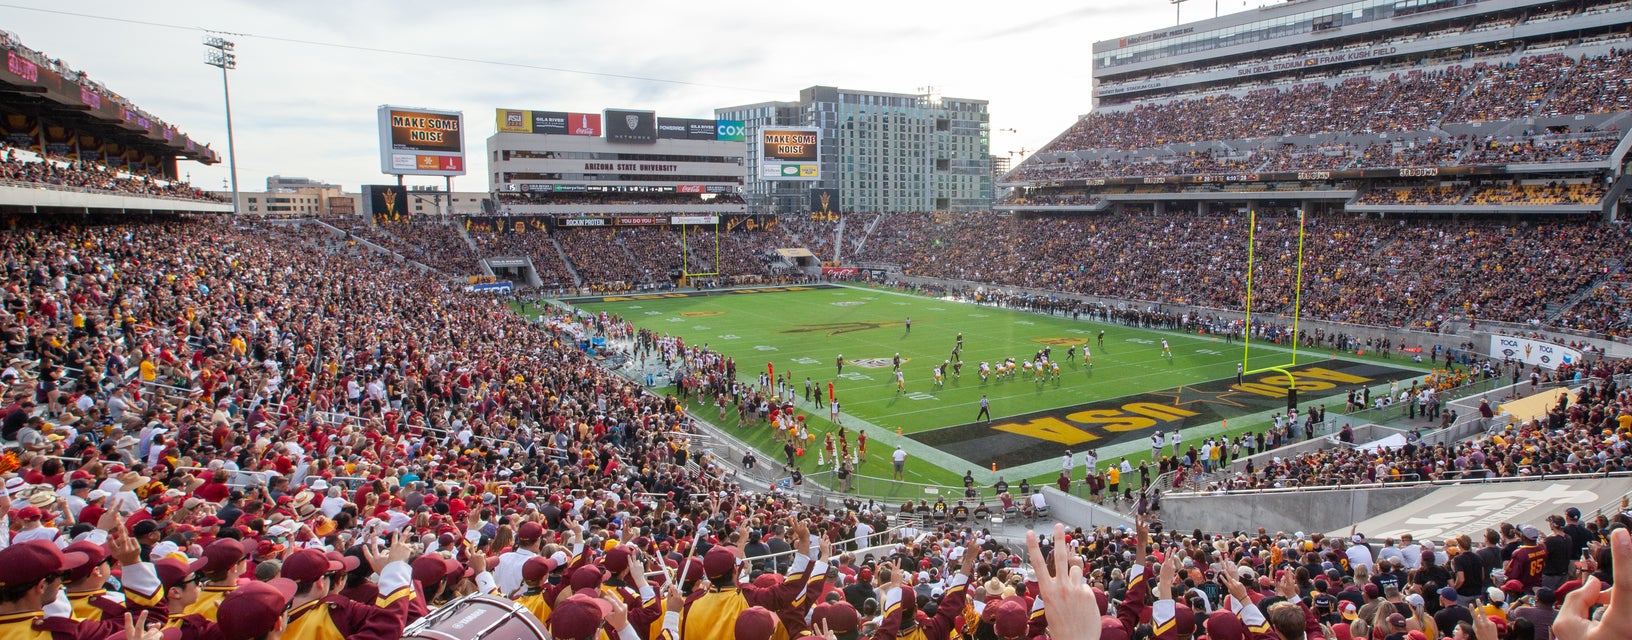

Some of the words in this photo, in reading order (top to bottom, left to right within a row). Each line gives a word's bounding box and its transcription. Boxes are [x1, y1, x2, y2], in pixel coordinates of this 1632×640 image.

[1253, 66, 1271, 74] DEVIL
[1273, 61, 1302, 71] STADIUM
[1320, 55, 1345, 64] FRANK
[1347, 51, 1370, 60] KUSH
[1373, 47, 1396, 57] FIELD
[393, 116, 426, 128] MAKE
[428, 119, 458, 131] SOME
[411, 129, 443, 142] NOISE
[717, 125, 745, 136] COX
[765, 134, 790, 144] MAKE
[792, 135, 816, 144] SOME
[778, 145, 803, 154] NOISE
[585, 162, 613, 170] ARIZONA
[617, 163, 637, 171] STATE
[1501, 339, 1518, 348] TOCA
[1539, 345, 1553, 354] TOCA
